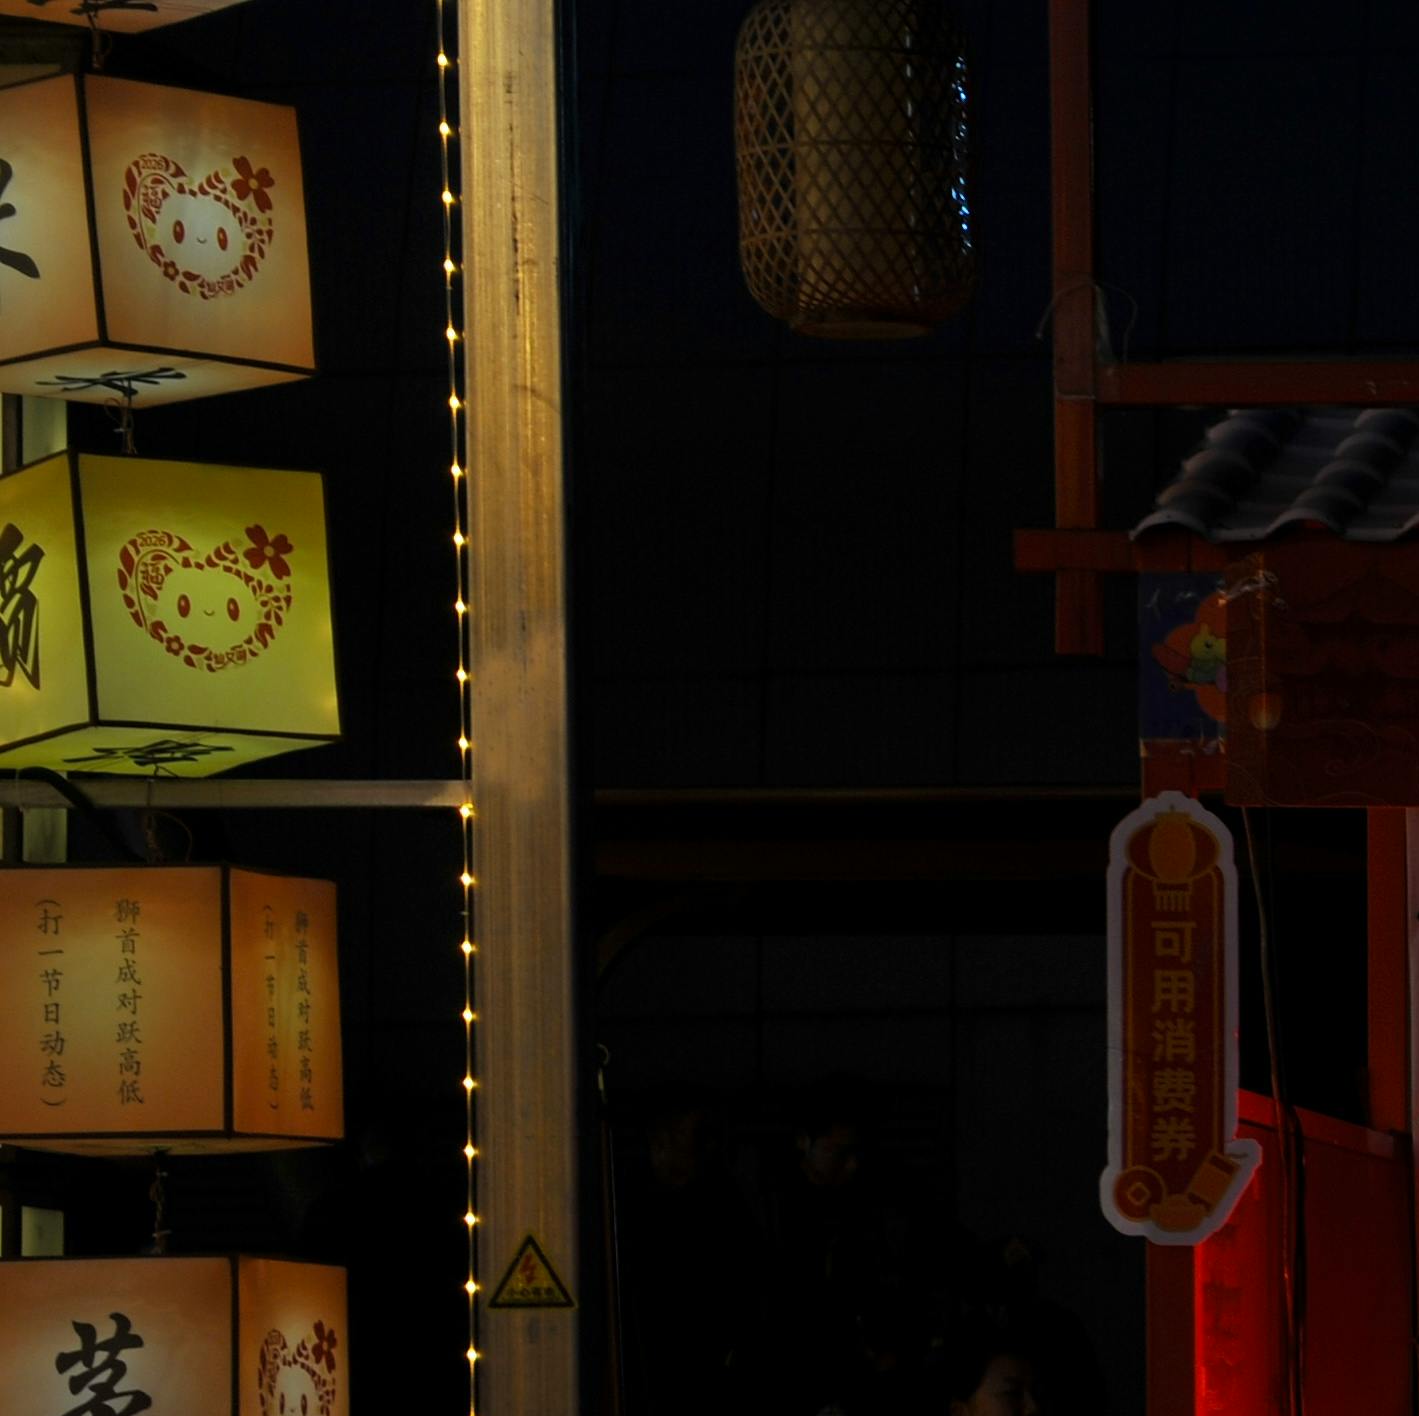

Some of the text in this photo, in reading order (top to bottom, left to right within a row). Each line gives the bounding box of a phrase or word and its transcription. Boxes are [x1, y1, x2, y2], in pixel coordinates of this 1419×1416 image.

[114, 898, 145, 1106] 狮首成对跃高低
[1151, 919, 1197, 1163] 可用消费券
